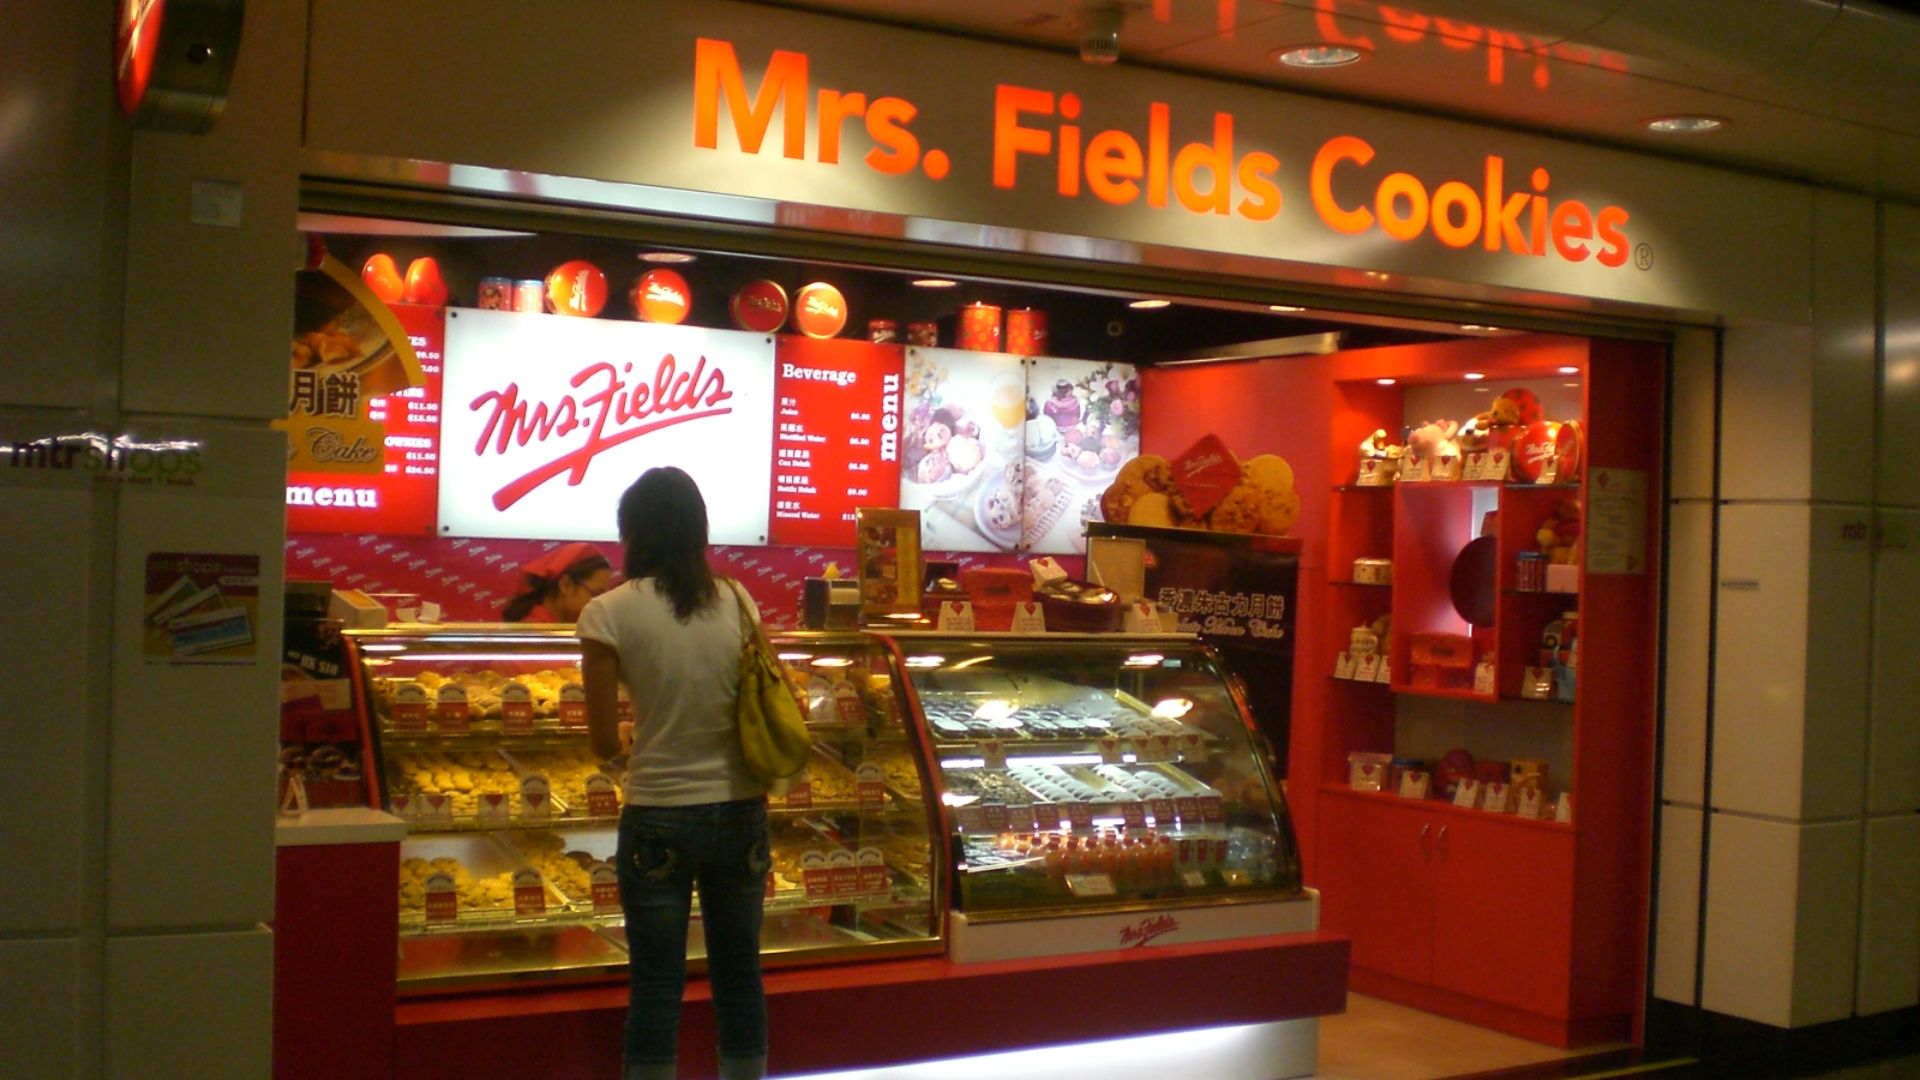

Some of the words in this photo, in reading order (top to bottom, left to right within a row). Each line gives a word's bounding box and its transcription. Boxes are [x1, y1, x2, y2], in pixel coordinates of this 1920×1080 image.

[694, 37, 951, 181] Mrs.
[992, 83, 1283, 221] Fields
[1310, 135, 1630, 268] Cookies
[289, 369, 362, 418] 月餅
[782, 363, 857, 387] Beverage
[469, 382, 589, 456] Mrs.
[567, 353, 733, 487] Fields
[880, 374, 900, 462] menu
[305, 426, 378, 463] Cake
[283, 485, 378, 508] menu
